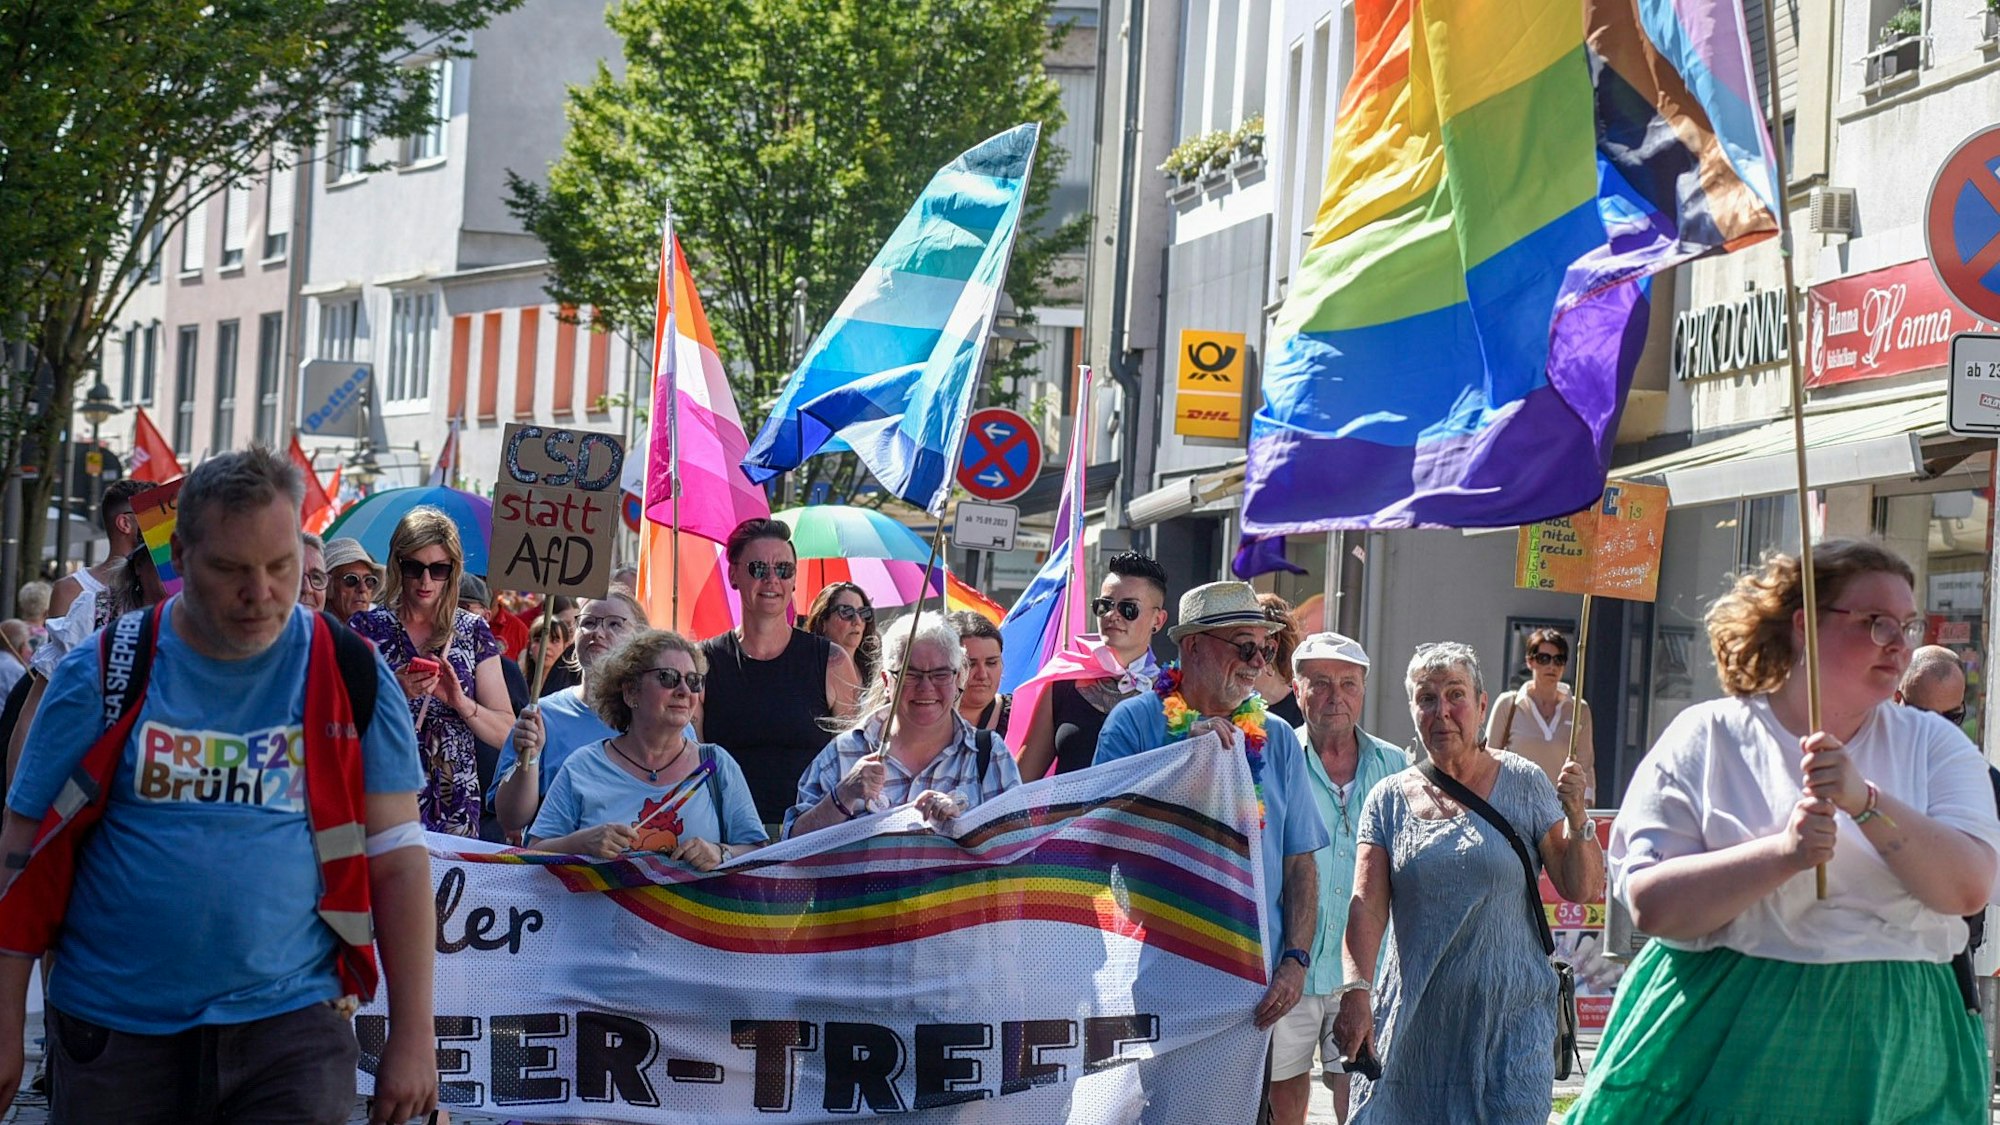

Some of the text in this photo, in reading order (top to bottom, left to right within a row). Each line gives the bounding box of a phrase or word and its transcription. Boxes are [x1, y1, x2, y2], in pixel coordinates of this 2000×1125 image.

[1675, 304, 1718, 381] OPTIK
[1828, 302, 1859, 336] Hanna
[1862, 283, 1952, 368] Hanna
[1966, 362, 1981, 377] ab
[1187, 409, 1231, 422] DHL
[506, 426, 625, 491] CSD
[500, 489, 602, 535] statt
[504, 532, 594, 587] AfD
[434, 866, 544, 955] ler
